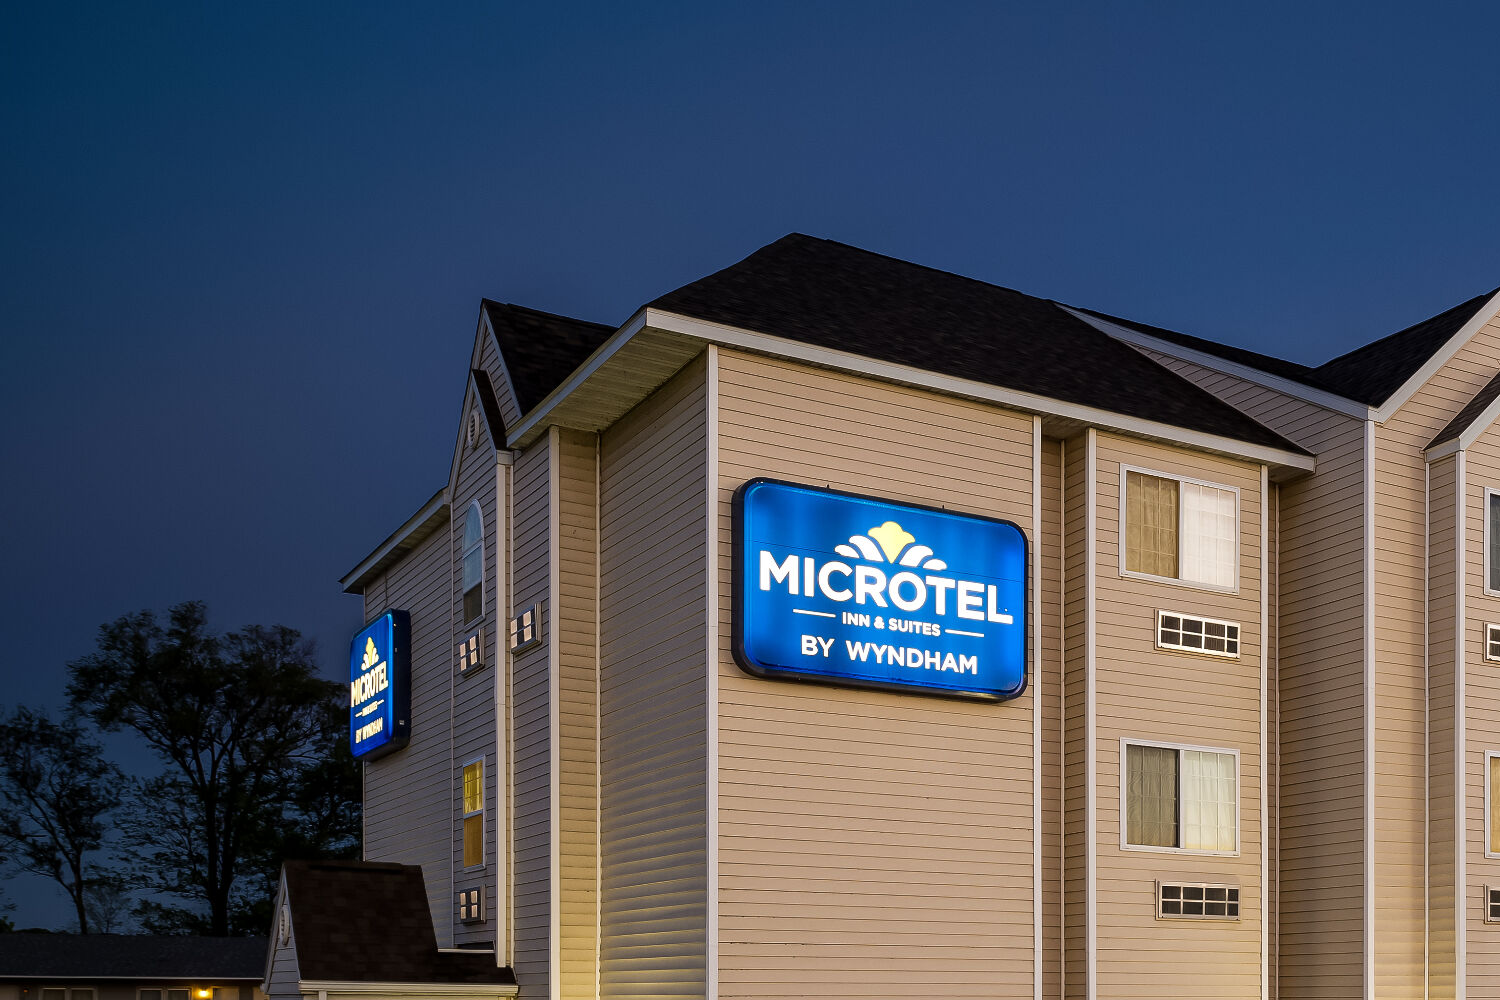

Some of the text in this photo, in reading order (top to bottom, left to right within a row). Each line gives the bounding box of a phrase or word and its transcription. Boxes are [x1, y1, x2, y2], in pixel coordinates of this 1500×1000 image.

[759, 550, 1014, 625] MICROTEL
[842, 611, 941, 637] INN & SUITES
[801, 634, 978, 675] BY WYNDHAM
[350, 660, 389, 708] MICROTEL
